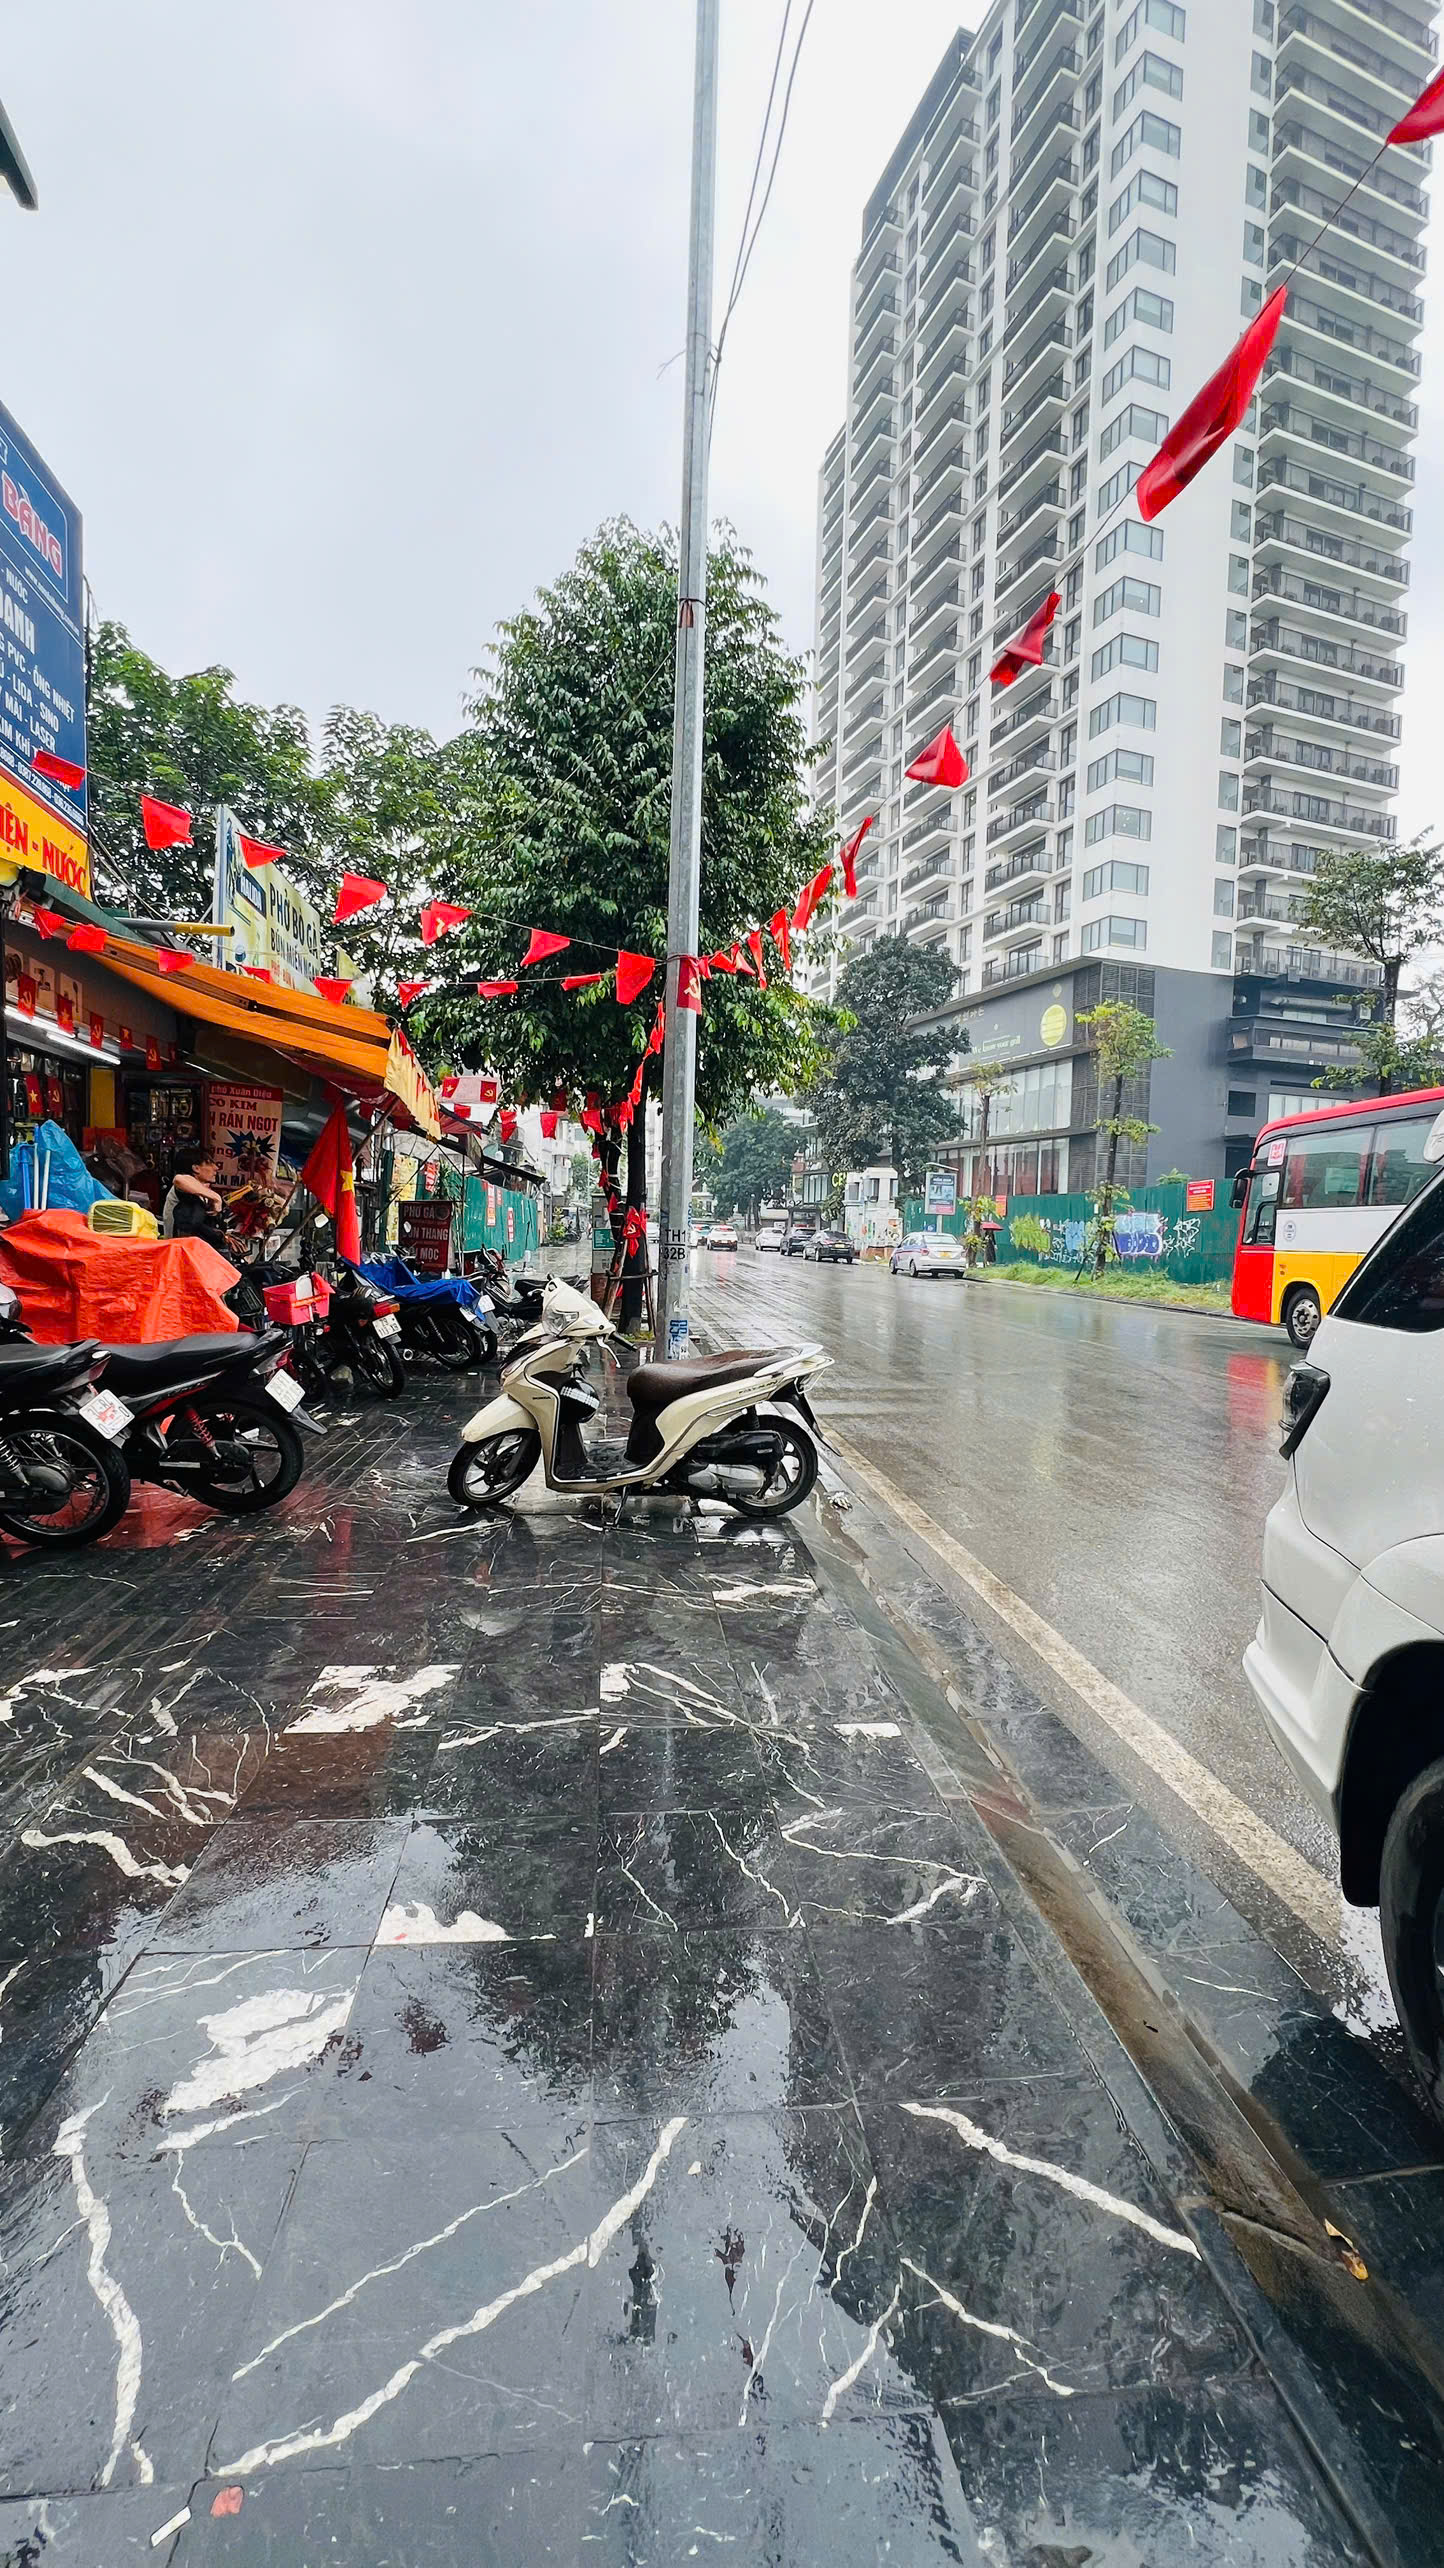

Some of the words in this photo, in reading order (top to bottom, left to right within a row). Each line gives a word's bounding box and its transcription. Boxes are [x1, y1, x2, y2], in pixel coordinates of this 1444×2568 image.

[7, 640, 26, 673] PVC
[39, 701, 59, 733] SINO
[30, 715, 56, 754] LASER
[42, 836, 86, 896] NƯỚC
[269, 882, 291, 932] PHỞ
[230, 1099, 257, 1111] KIM
[219, 1110, 243, 1128] RÁN
[247, 1115, 279, 1135] NGỌT
[421, 1227, 449, 1241] THANG
[665, 1229, 686, 1242] TH1
[663, 1247, 686, 1260] 32B
